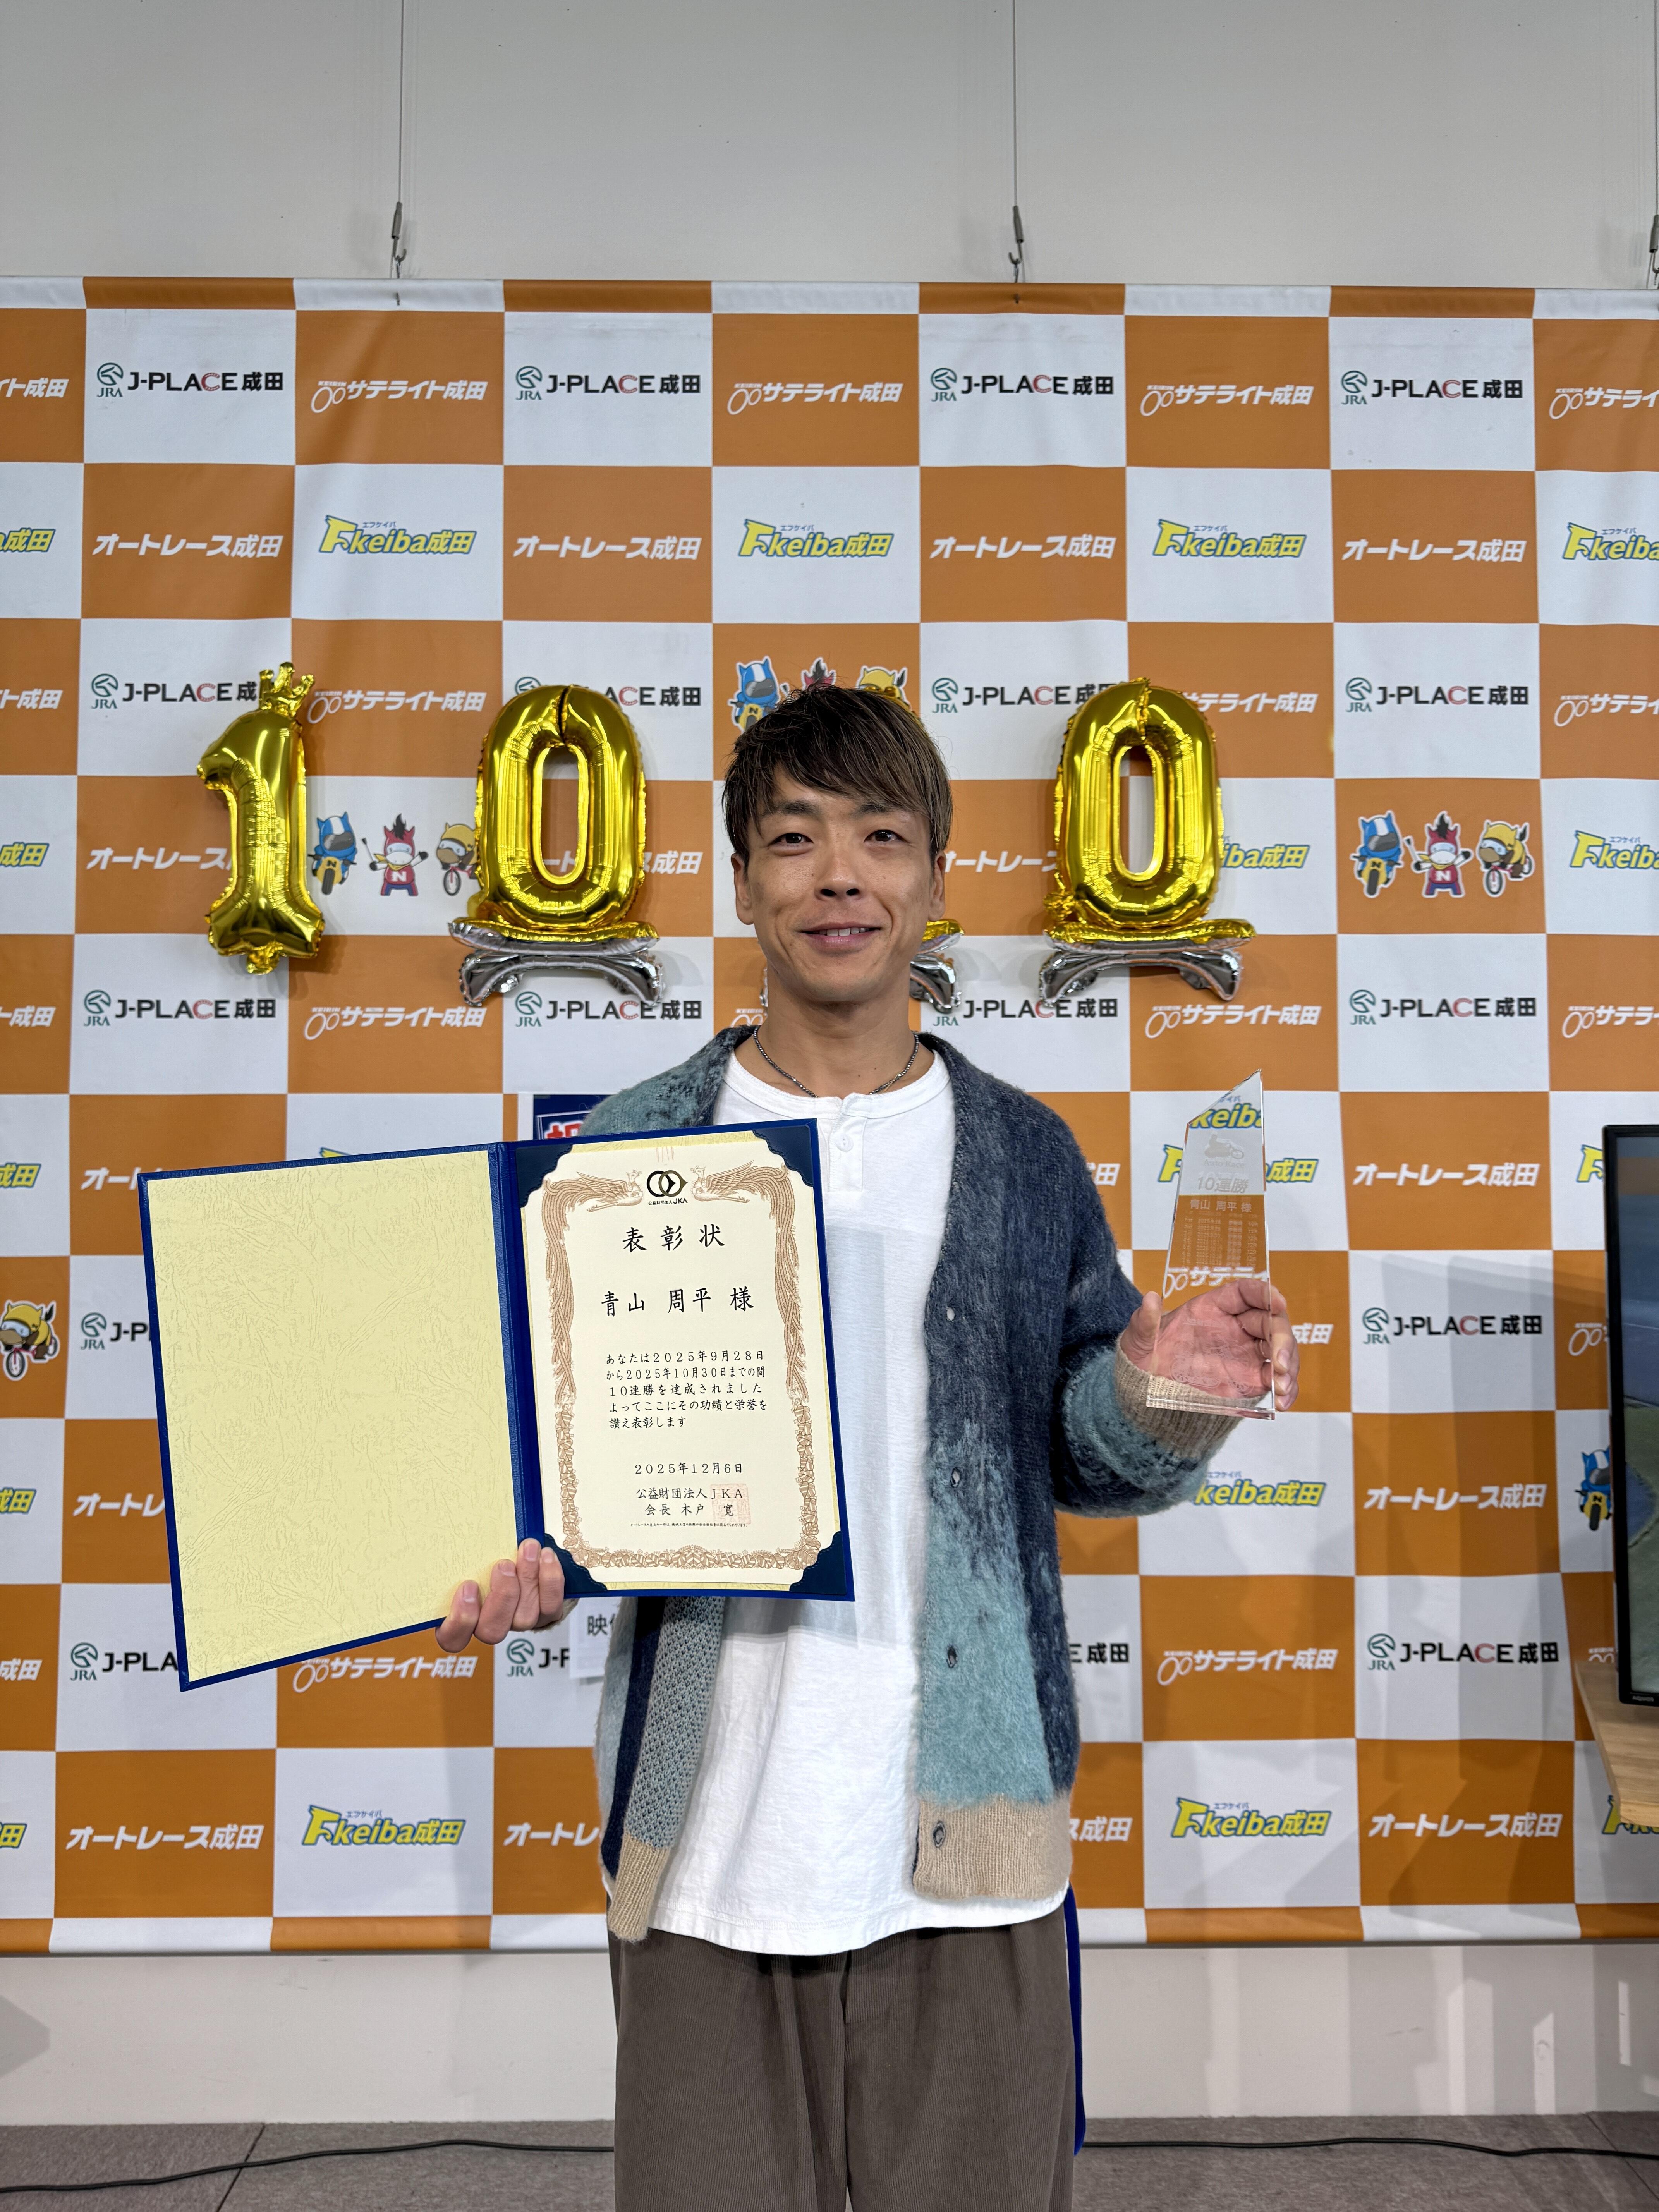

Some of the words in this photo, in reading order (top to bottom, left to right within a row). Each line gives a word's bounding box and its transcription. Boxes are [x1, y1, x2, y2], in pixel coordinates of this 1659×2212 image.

[127, 371, 283, 392] J-PLACE成田
[347, 380, 488, 400] サテライト成田
[546, 374, 701, 394] J-PLACE成田
[961, 375, 1113, 395] J-PLACE成田
[1372, 379, 1523, 399] J-PLACE成田
[97, 387, 123, 397] JRA
[516, 390, 542, 400] JRA
[763, 382, 903, 402] サテライト成田
[931, 392, 957, 402] JRA
[1175, 385, 1314, 405] サテライト成田
[1342, 395, 1368, 405] JRA
[93, 534, 283, 558] オートレース成田
[514, 536, 702, 560] オートレース成田
[930, 534, 1116, 559] オートレース成田
[1342, 539, 1527, 562] オートレース成田
[0, 689, 63, 709] ト成田
[122, 681, 257, 702] J-PLACE成
[343, 690, 487, 711] サテライト成田
[604, 686, 701, 708] ACE成田
[962, 684, 1119, 708] J-PLACE成
[1377, 685, 1528, 706] J-PLACE成田
[91, 699, 117, 709] JRA
[933, 701, 958, 713] JRA
[1346, 702, 1372, 713] JRA
[86, 847, 231, 870] オートレース
[1218, 844, 1309, 869] iba成田
[391, 871, 408, 882] N
[1434, 869, 1451, 882] N
[115, 998, 276, 1019] J-PLACE成田
[341, 1005, 487, 1027] サテライト成田
[545, 999, 704, 1021] J-PLACE成田
[1182, 1004, 1321, 1025] サテライト成田
[1380, 997, 1536, 1017] J-PLACE成田
[1595, 1005, 1659, 1025] サテラ
[84, 1016, 110, 1027] JRA
[516, 1017, 542, 1027] JRA
[933, 1012, 958, 1026] JRA
[1351, 1015, 1376, 1025] JRA
[1353, 1162, 1540, 1186] オートレース成田
[1197, 1177, 1249, 1194] 10連勝
[1216, 1201, 1238, 1211] 周平
[622, 1223, 725, 1253] 表彰状
[601, 1291, 644, 1317] 青山
[668, 1287, 711, 1314] 周平
[730, 1286, 754, 1312] 様
[109, 1321, 150, 1343] J-P
[1393, 1314, 1543, 1336] J-PLACE成田
[81, 1339, 105, 1350] JRA
[1364, 1334, 1390, 1344] JRA
[606, 1350, 763, 1364] あなたは2025年9月28日
[606, 1366, 765, 1381] から2025年10月30日までの間
[610, 1382, 762, 1396] 10連勝を達成されました
[610, 1398, 767, 1413] よってここにその功績と栄誉を
[609, 1416, 686, 1429] 讃え表彰します
[635, 1462, 742, 1475] 2025年12月6日
[636, 1487, 744, 1500] 公益財団法人JKA
[1364, 1484, 1546, 1511] オートレース成田
[645, 1503, 671, 1516] 会長
[1193, 1648, 1338, 1671] サテライト成田
[1400, 1641, 1559, 1664] J-PLACE成田
[330, 1656, 477, 1678] サテライト成田
[508, 1666, 533, 1676] JRA
[1369, 1657, 1396, 1671] JRA
[70, 1669, 97, 1681] JRA
[1369, 1812, 1562, 1837] オートレース成田
[66, 1824, 264, 1850] オートレース成田
